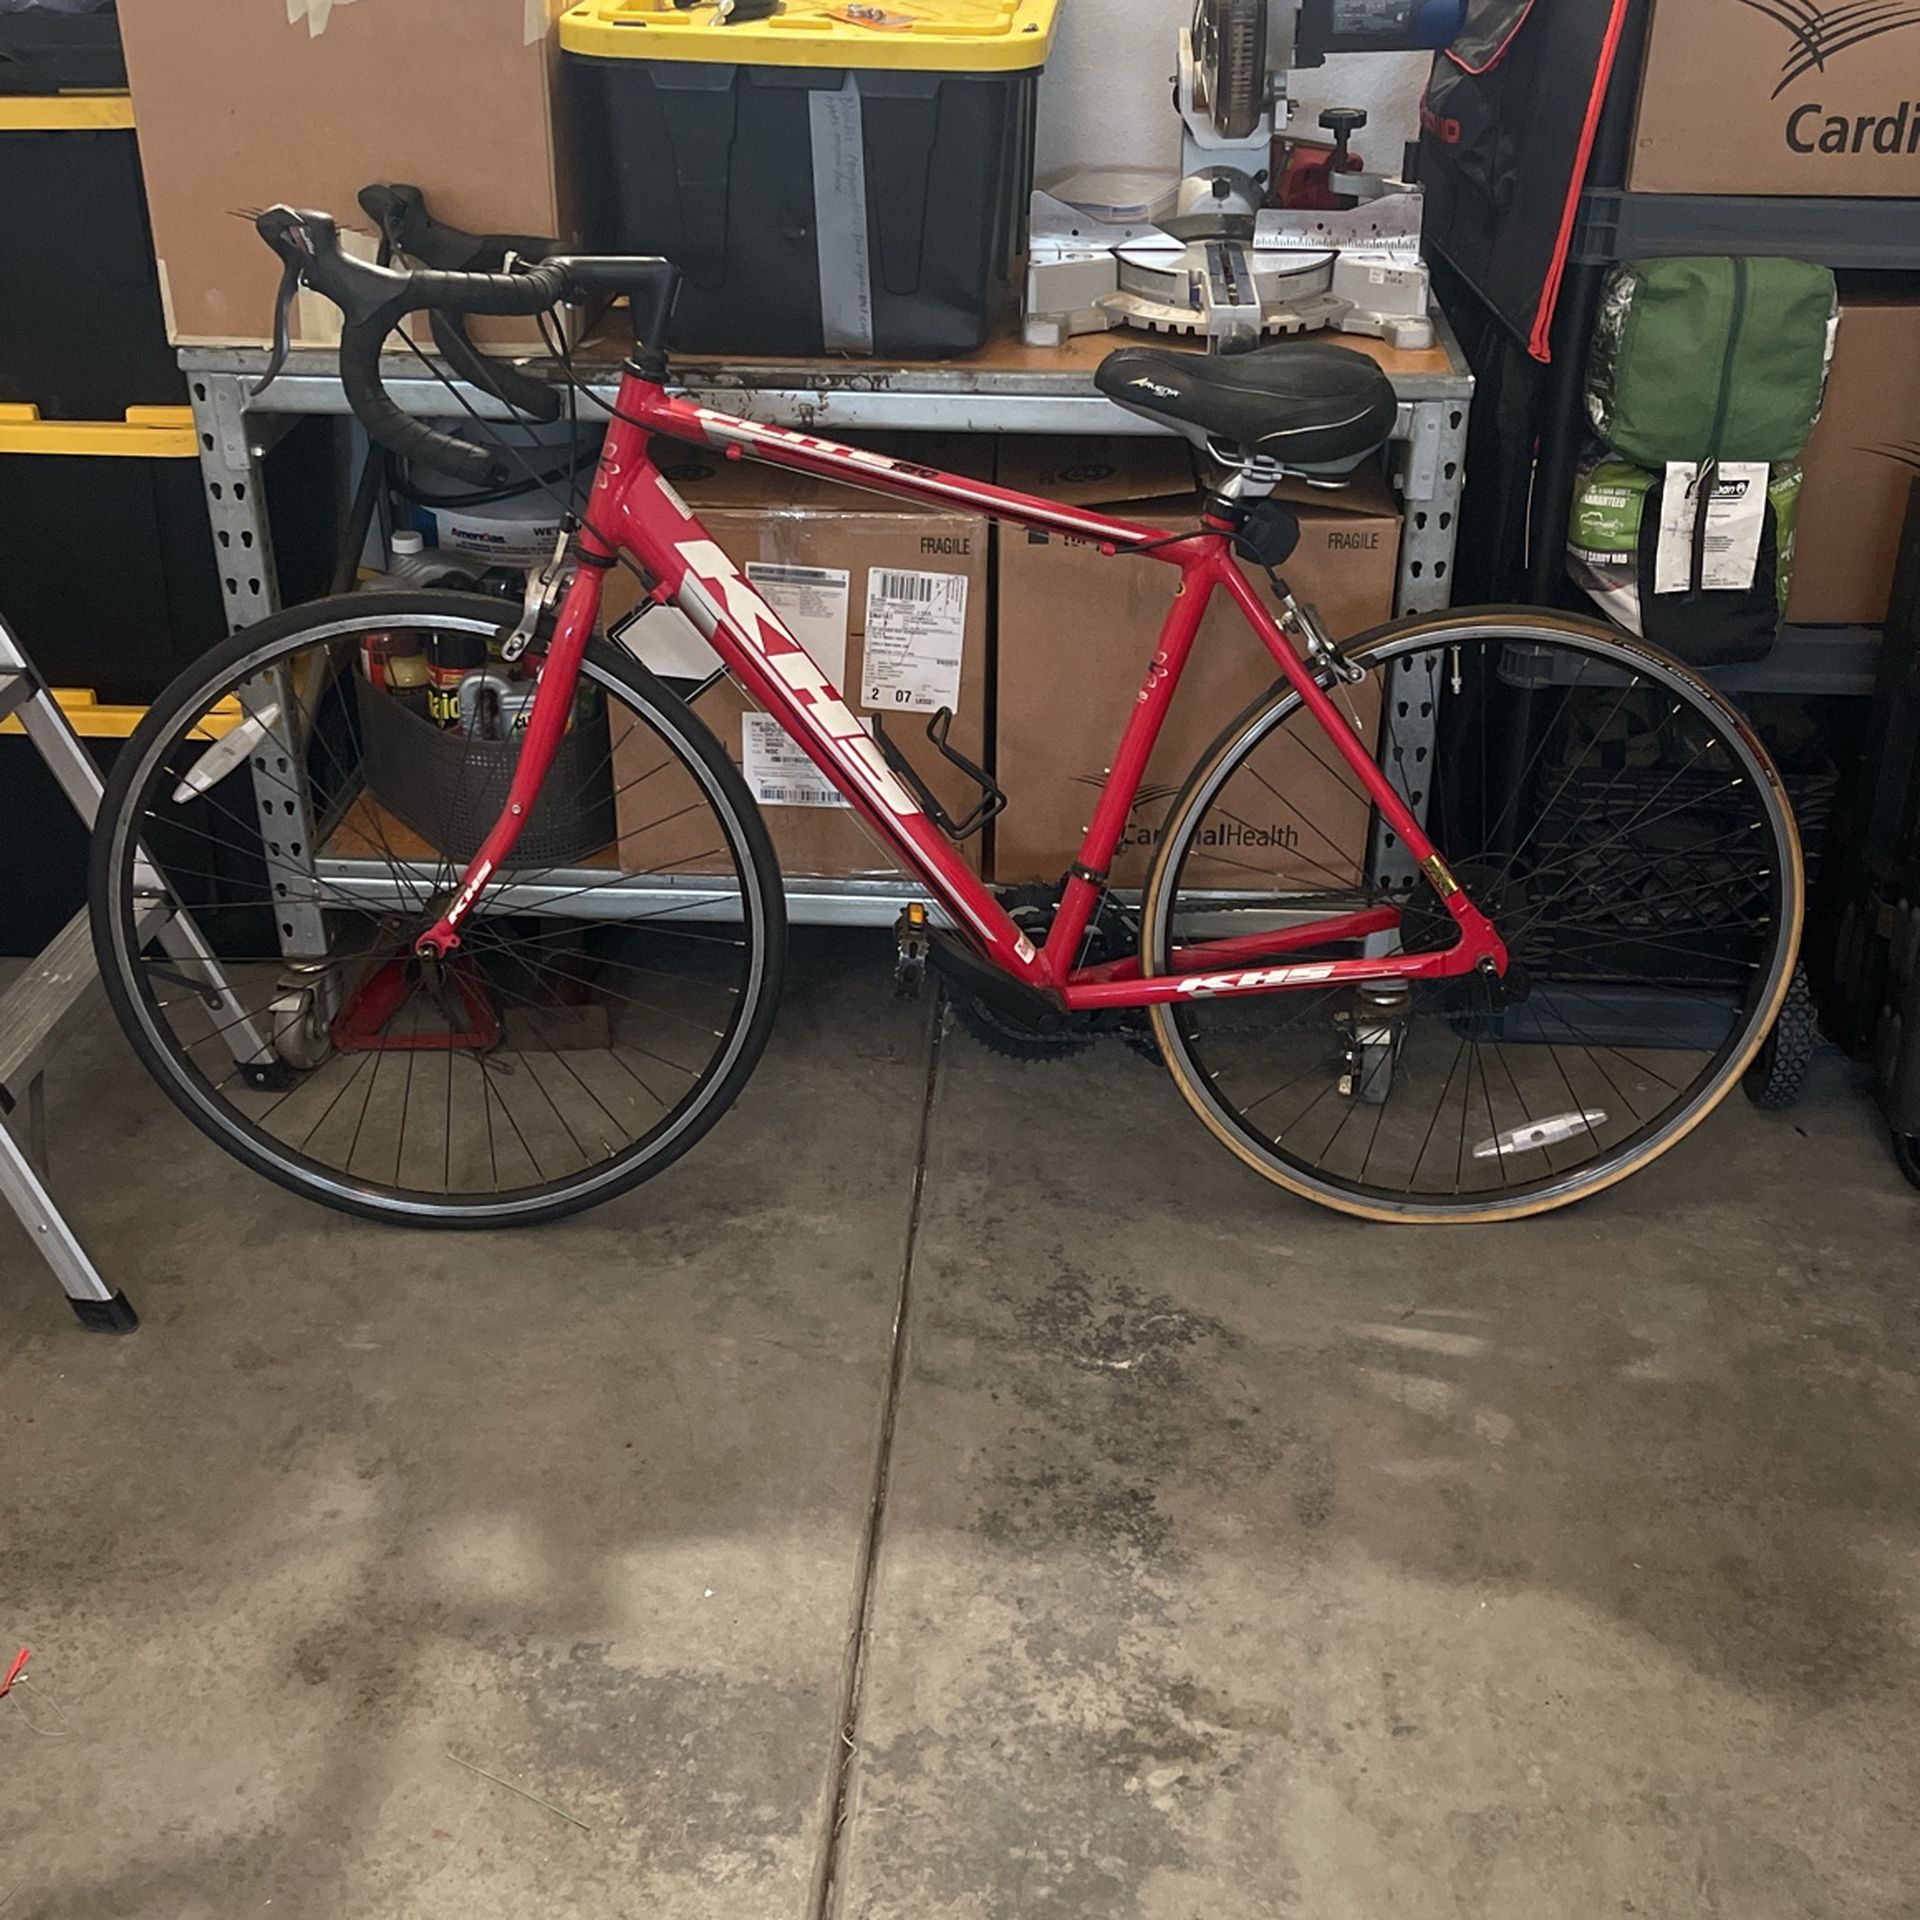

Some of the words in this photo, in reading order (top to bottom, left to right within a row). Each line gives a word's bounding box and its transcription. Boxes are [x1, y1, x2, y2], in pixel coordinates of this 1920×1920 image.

[1785, 101, 1920, 154] Cardi
[920, 537, 970, 555] FRAGILE
[1327, 532, 1379, 549] FRAGILE
[674, 540, 919, 815] KHS
[871, 687, 880, 700] 2
[895, 689, 912, 703] 07
[1121, 824, 1299, 847] CaralHealth
[448, 859, 492, 925] KHS
[1177, 965, 1336, 993] KHS
